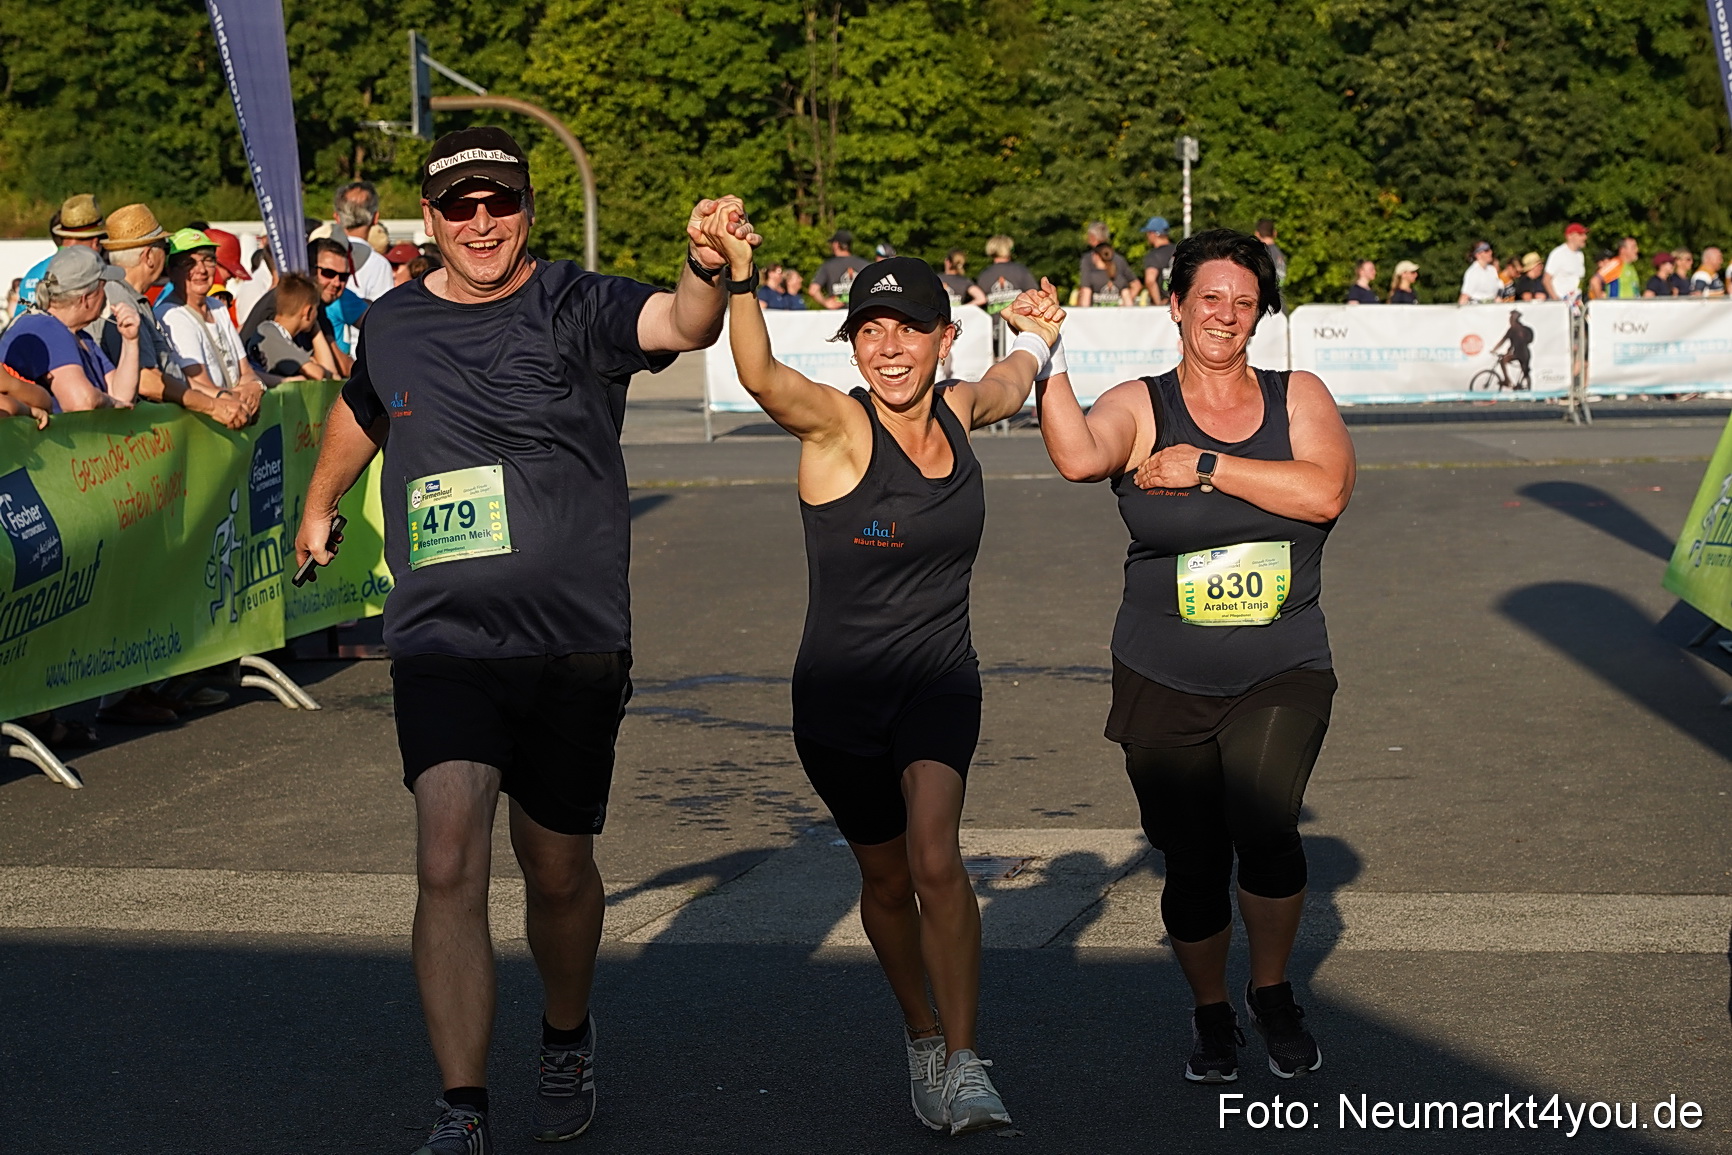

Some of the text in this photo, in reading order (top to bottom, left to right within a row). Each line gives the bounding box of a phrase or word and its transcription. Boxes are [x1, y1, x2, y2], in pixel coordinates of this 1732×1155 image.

[429, 156, 458, 174] CALVIN
[460, 150, 488, 161] KLEIN
[870, 283, 903, 294] adidas
[1314, 327, 1348, 339] NOW
[1613, 322, 1649, 334] NOW
[252, 459, 282, 483] Fischer
[6, 504, 43, 532] Fischer
[423, 500, 476, 535] 479
[489, 500, 503, 542] 2022
[469, 528, 492, 540] Meik
[863, 520, 896, 538] aha!
[877, 540, 889, 548] bei
[1207, 571, 1263, 600] 830
[1203, 600, 1269, 612] Arabet Tanja
